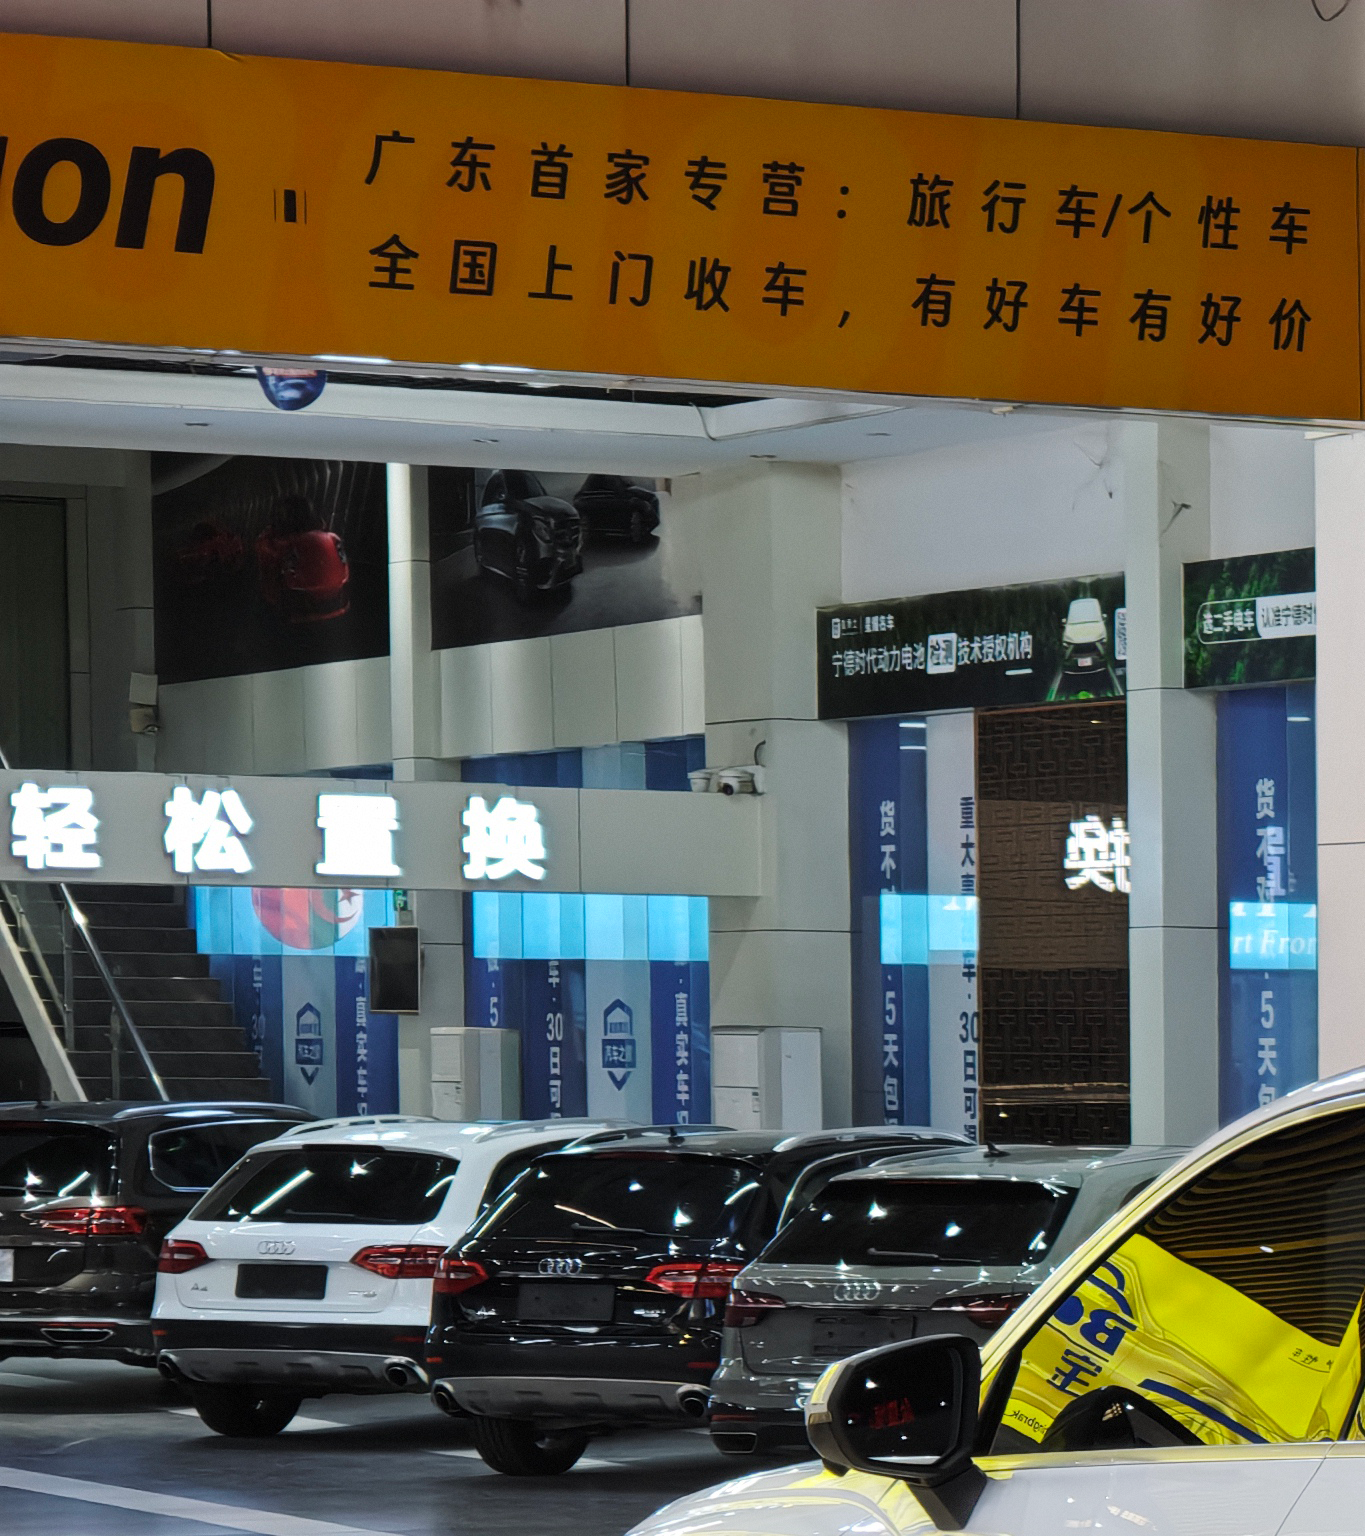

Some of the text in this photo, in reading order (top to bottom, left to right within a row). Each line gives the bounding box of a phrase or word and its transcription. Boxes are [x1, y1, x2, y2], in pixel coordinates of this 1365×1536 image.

[0, 137, 216, 254] on
[369, 234, 1312, 352] 全国上门收车，有好车有好价
[10, 782, 548, 880] 轻松置换
